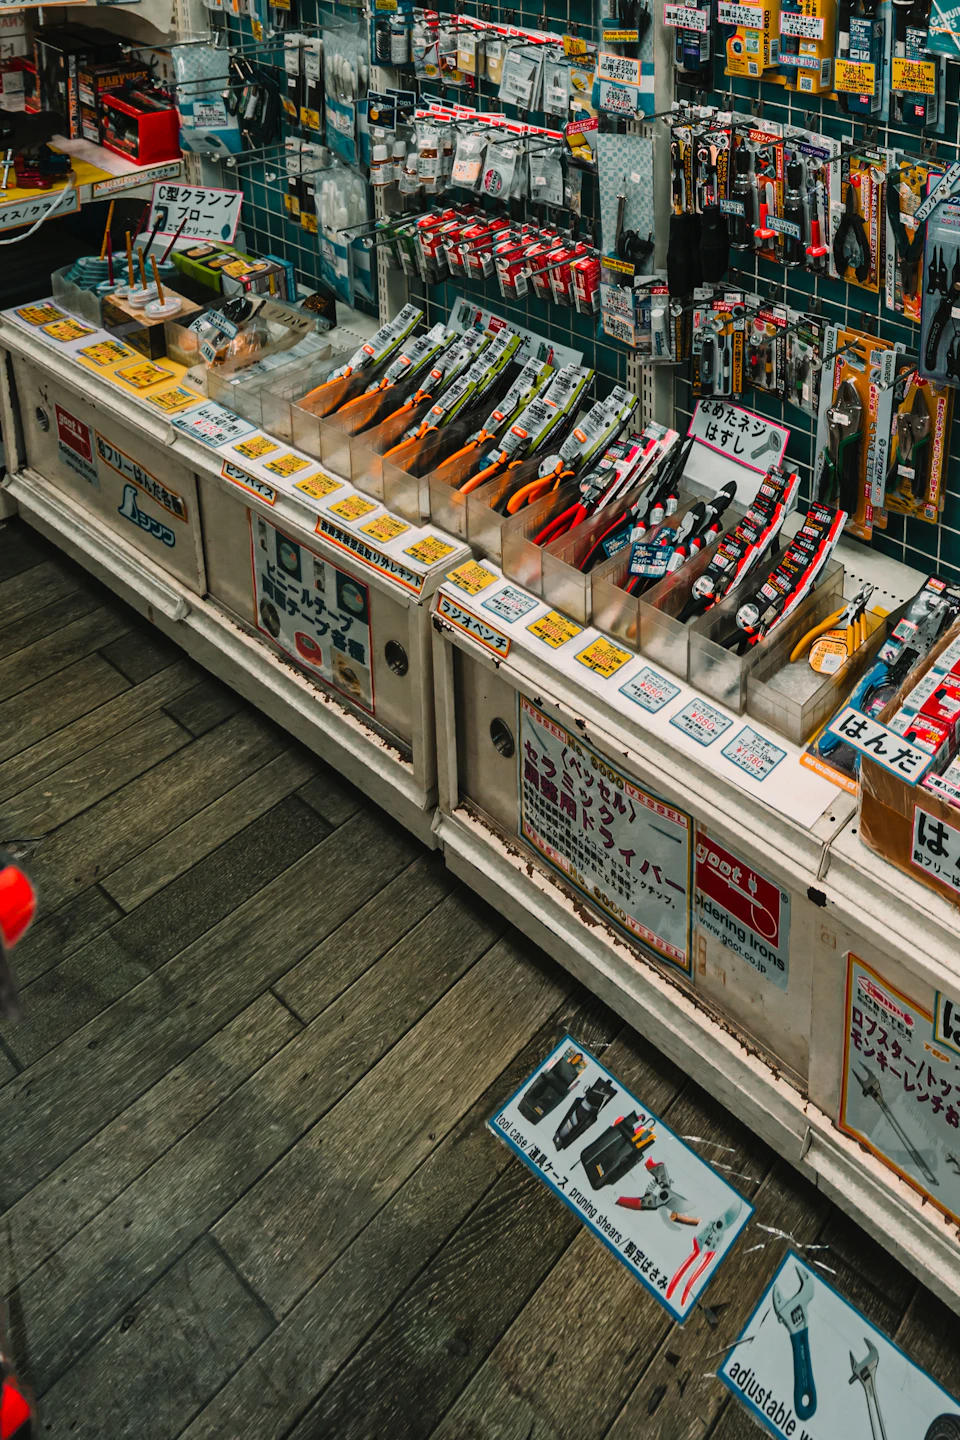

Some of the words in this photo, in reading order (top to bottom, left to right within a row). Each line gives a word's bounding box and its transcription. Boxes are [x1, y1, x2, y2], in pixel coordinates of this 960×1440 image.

[158, 185, 238, 208] C型クランプ
[700, 400, 766, 440] なめたネジ
[704, 422, 745, 455] はずし
[320, 520, 423, 588] 表面実装部品取り外しキット
[440, 598, 508, 651] ラジオペンチ
[523, 700, 566, 742] VESSEL
[626, 787, 688, 829] VESSEL
[837, 714, 923, 775] はんだ
[695, 841, 741, 883] goot
[628, 918, 686, 963] VESSEL
[695, 892, 747, 944] oldering
[748, 931, 786, 973] Irons
[857, 987, 914, 1040] LOBSTER
[728, 1362, 795, 1436] adjustable
